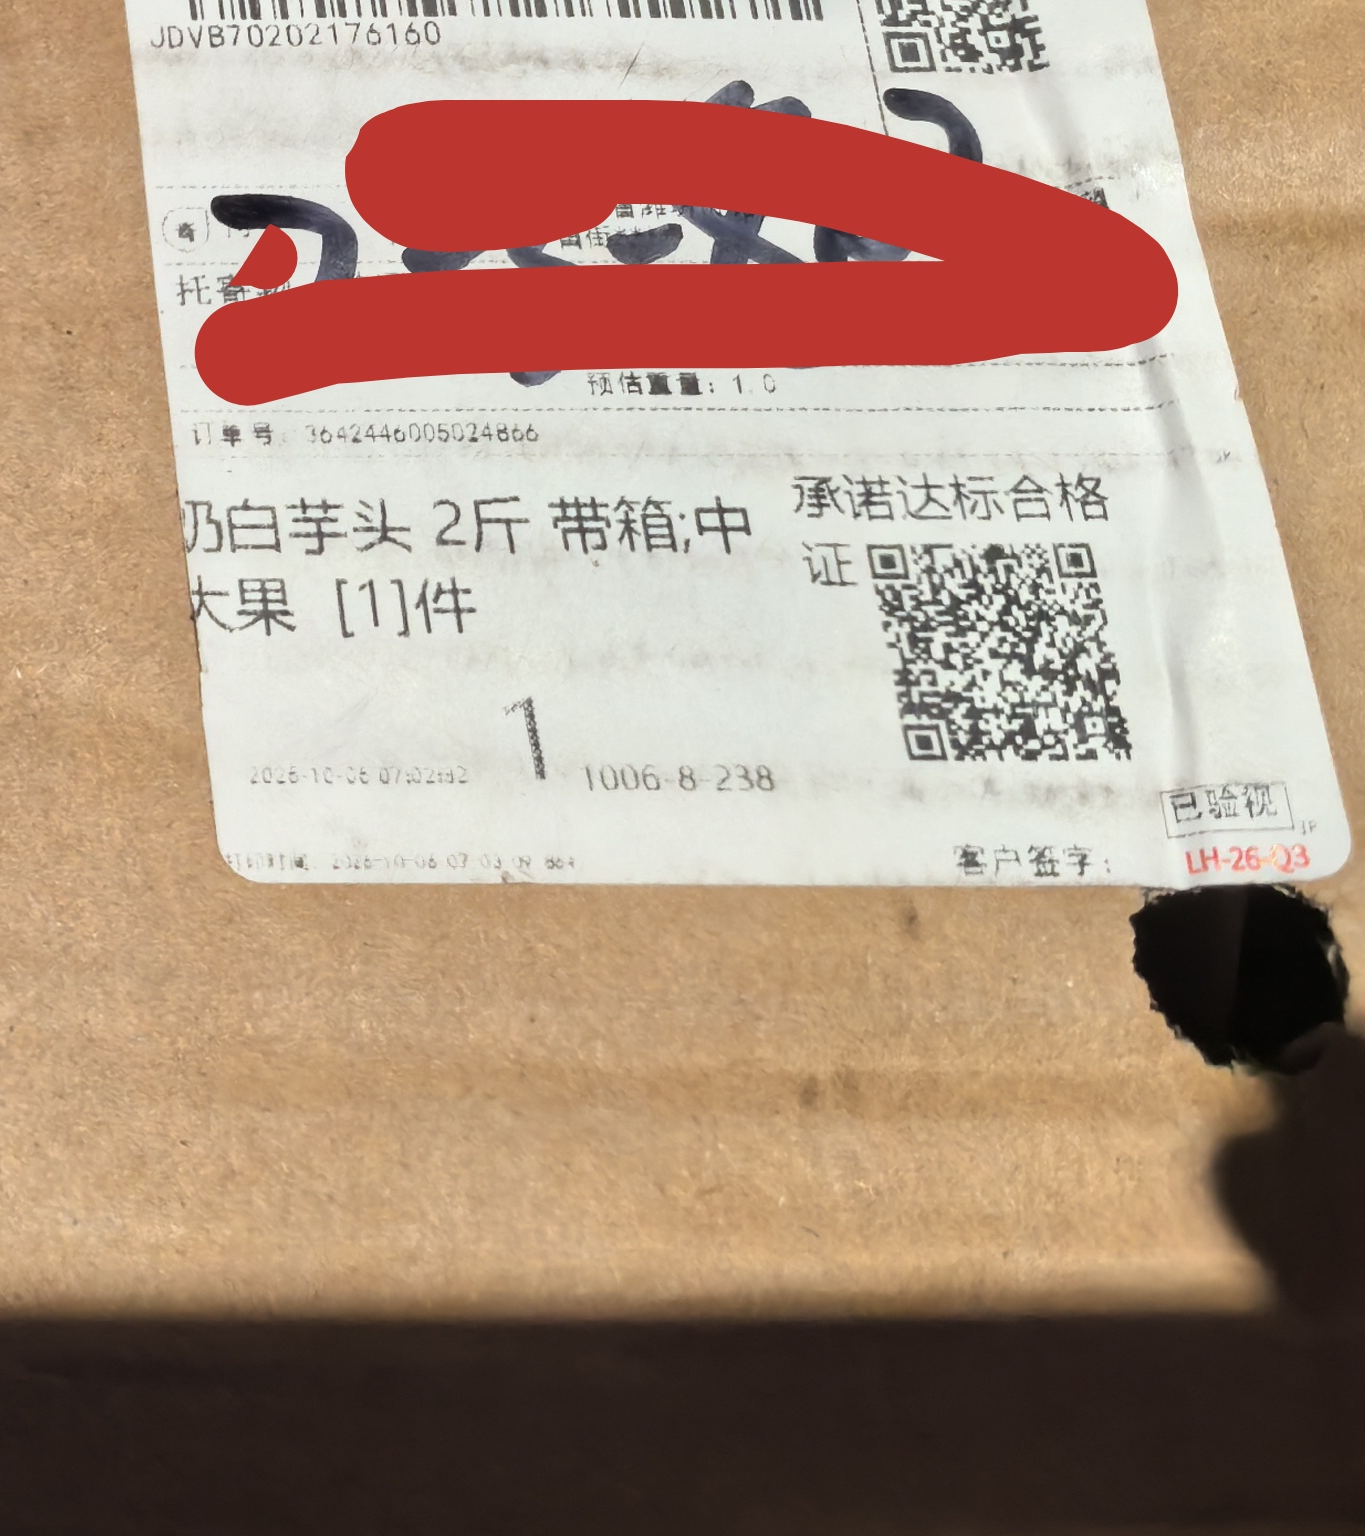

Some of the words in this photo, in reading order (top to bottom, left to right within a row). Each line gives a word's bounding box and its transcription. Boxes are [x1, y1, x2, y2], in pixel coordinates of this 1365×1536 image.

[151, 20, 442, 50] JDVB70202176160
[792, 473, 1111, 524] 承诺达标合格
[433, 494, 531, 555] 2斤
[802, 541, 859, 588] 证
[335, 576, 478, 639] [1]件
[502, 695, 548, 781] 1
[1185, 843, 1311, 875] LH-26-Q3
